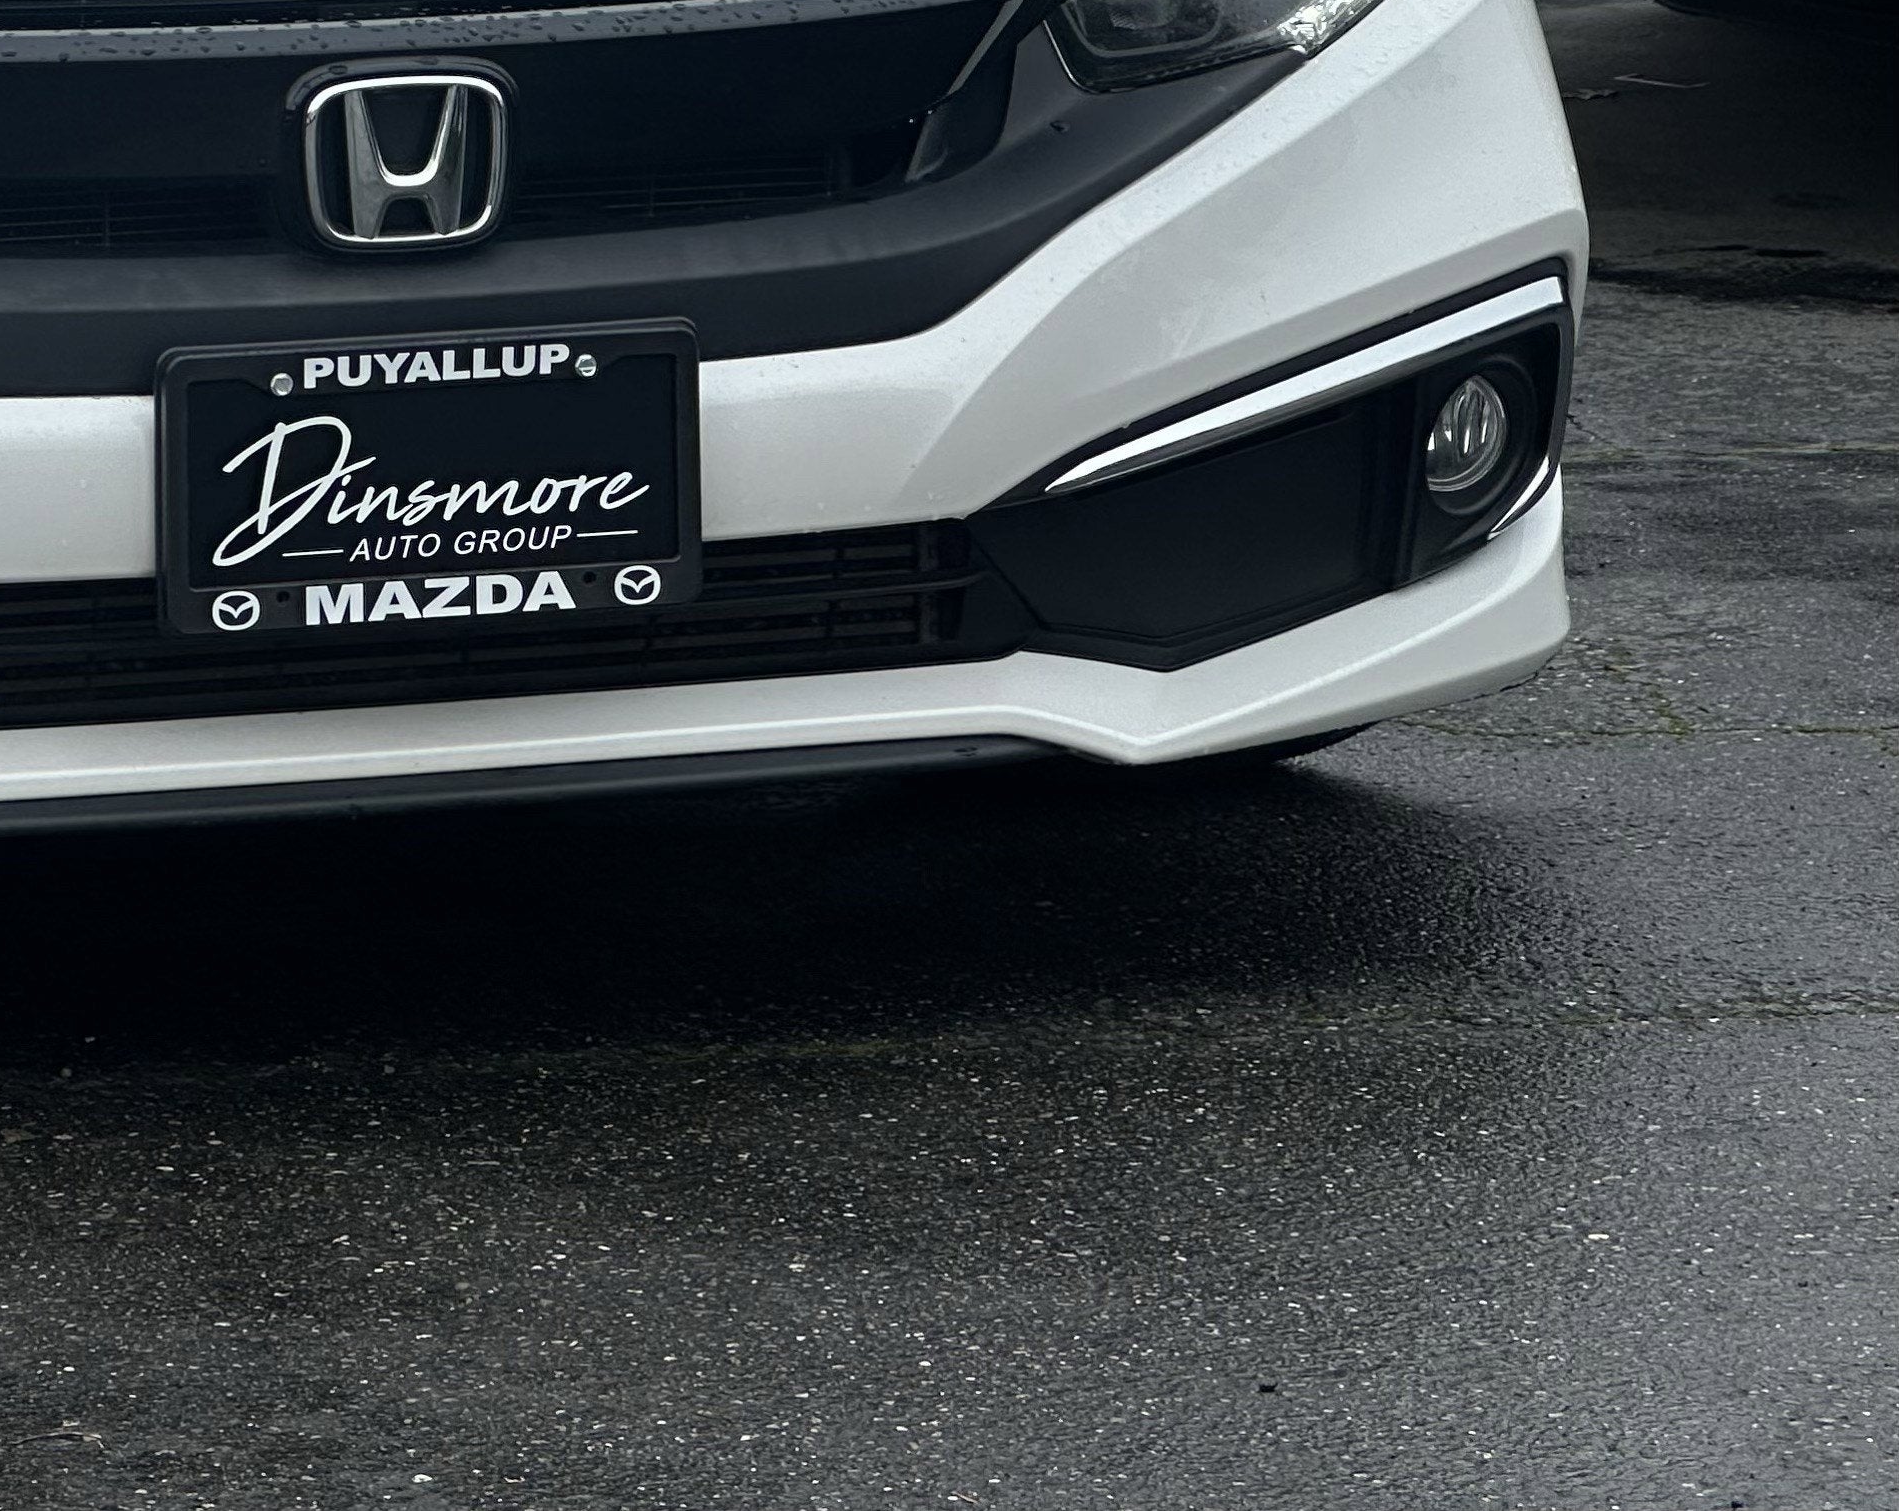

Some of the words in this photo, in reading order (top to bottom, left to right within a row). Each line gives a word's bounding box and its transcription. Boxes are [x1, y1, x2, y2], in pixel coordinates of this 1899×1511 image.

[303, 343, 571, 390] PUYALLUP
[212, 415, 651, 567] Dinsmore
[349, 532, 442, 563] AUTO
[453, 524, 573, 556] GROUP
[304, 570, 577, 627] MAZDA
